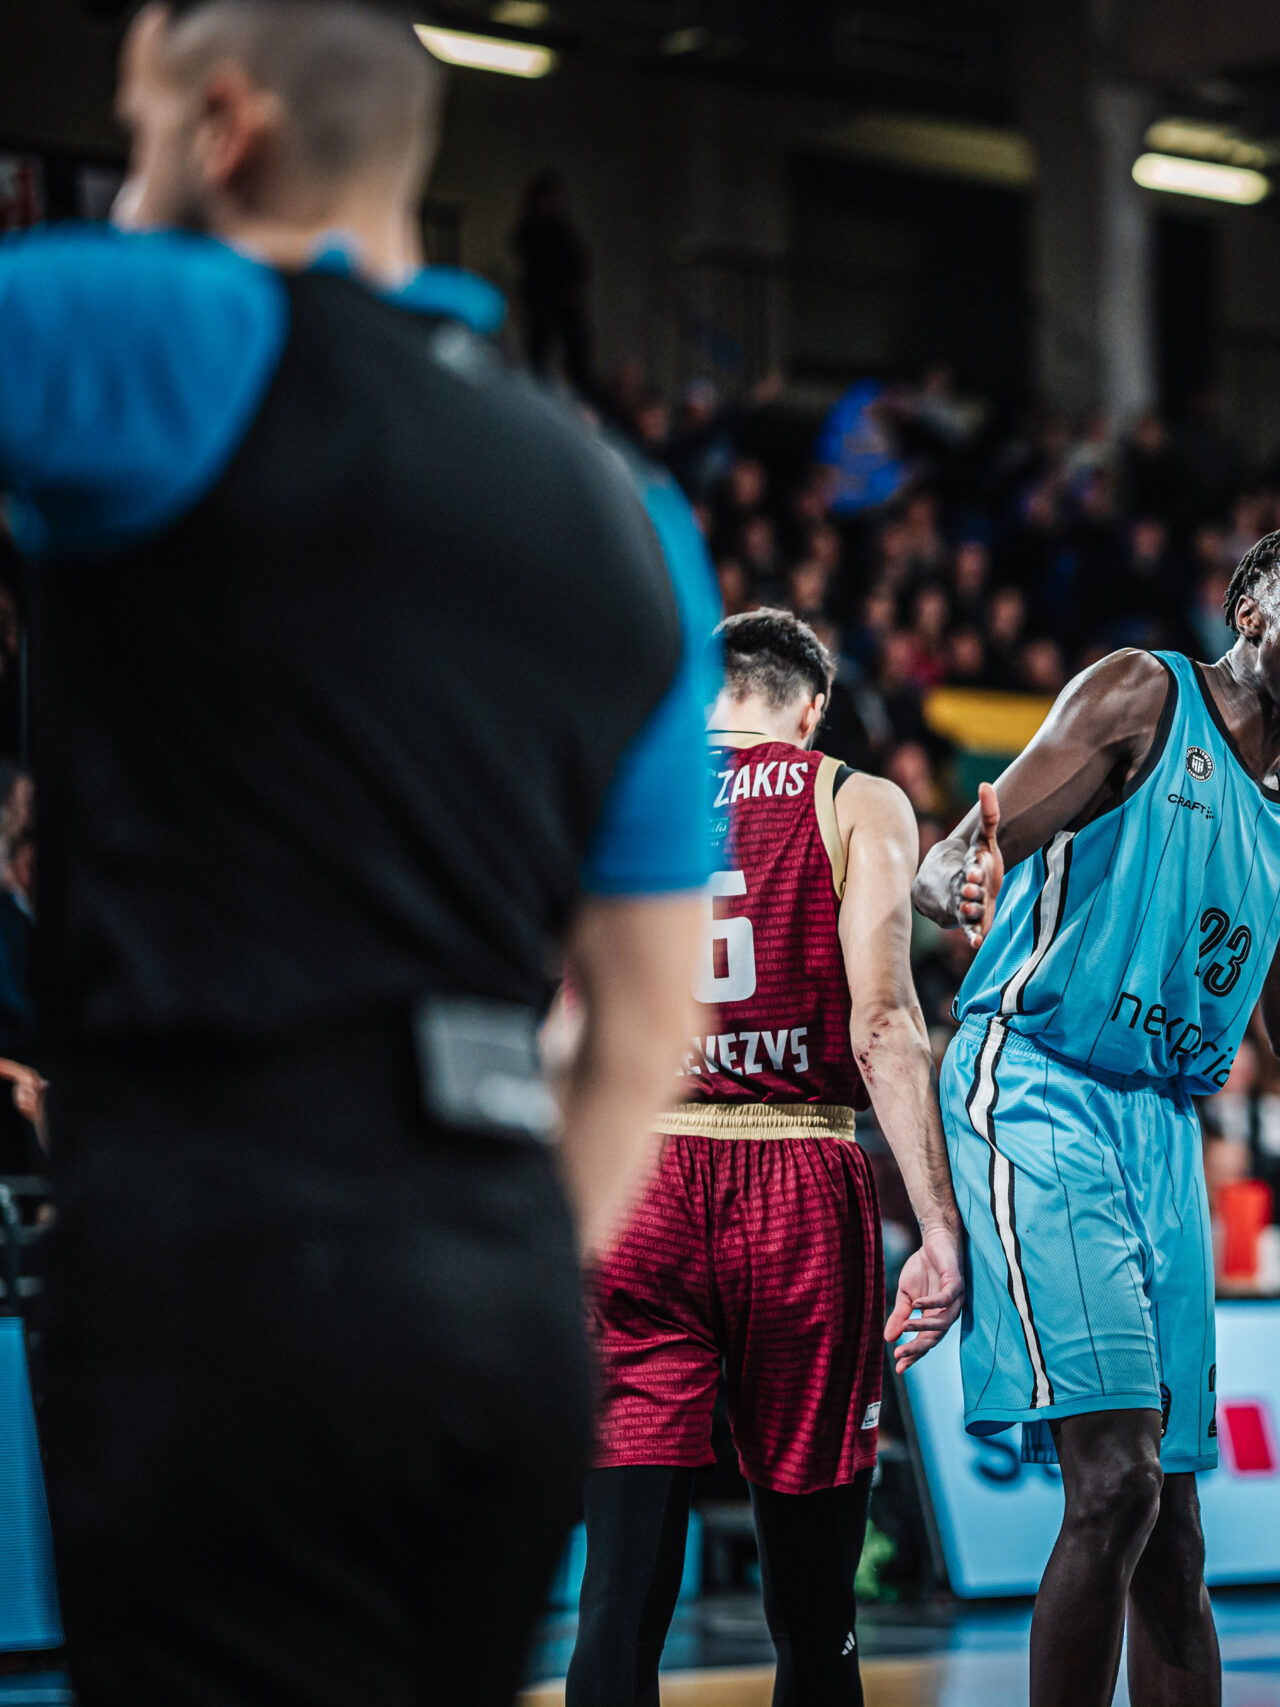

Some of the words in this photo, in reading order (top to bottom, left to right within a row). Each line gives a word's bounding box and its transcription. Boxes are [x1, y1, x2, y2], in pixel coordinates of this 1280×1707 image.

[712, 761, 808, 808] ZAKIS
[1167, 793, 1206, 814] CRAFT
[1194, 907, 1252, 997] 23
[675, 1027, 809, 1076] EVEZYS
